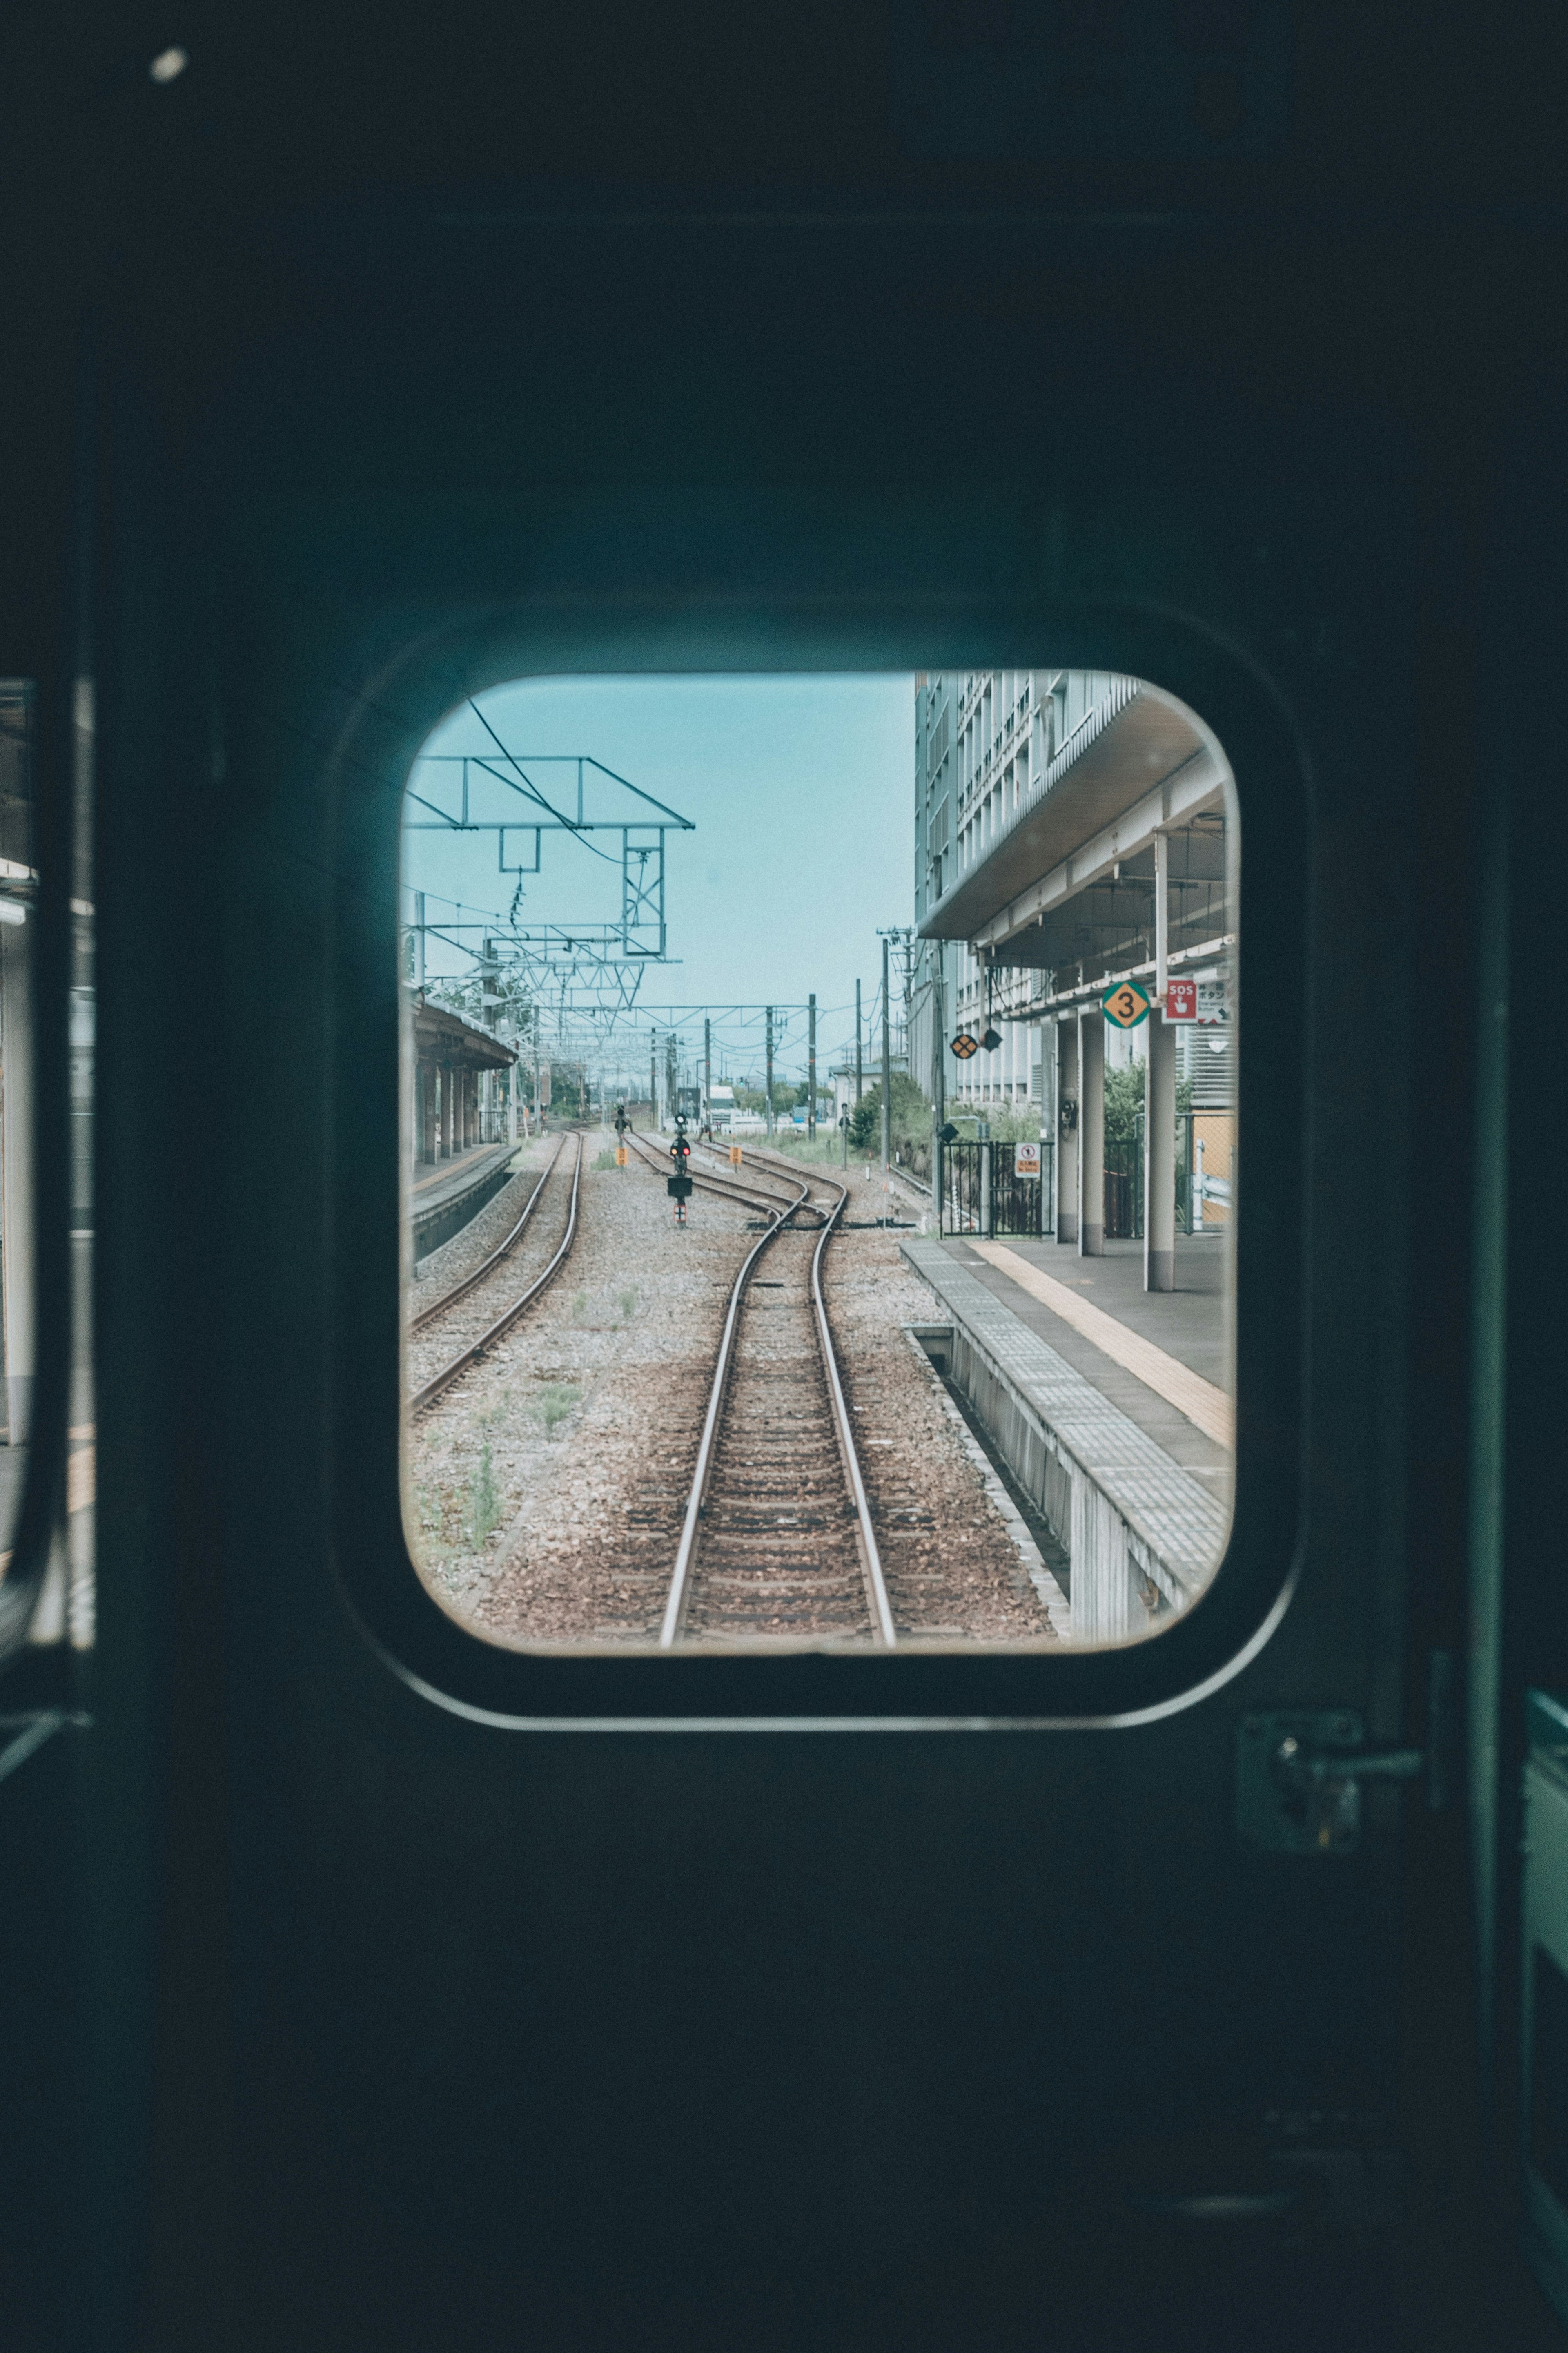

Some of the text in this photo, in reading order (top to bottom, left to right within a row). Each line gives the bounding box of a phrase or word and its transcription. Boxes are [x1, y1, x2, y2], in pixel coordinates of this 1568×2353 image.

[1169, 985, 1193, 995] SOS
[1199, 991, 1224, 999] ボタン
[1118, 992, 1134, 1018] 3
